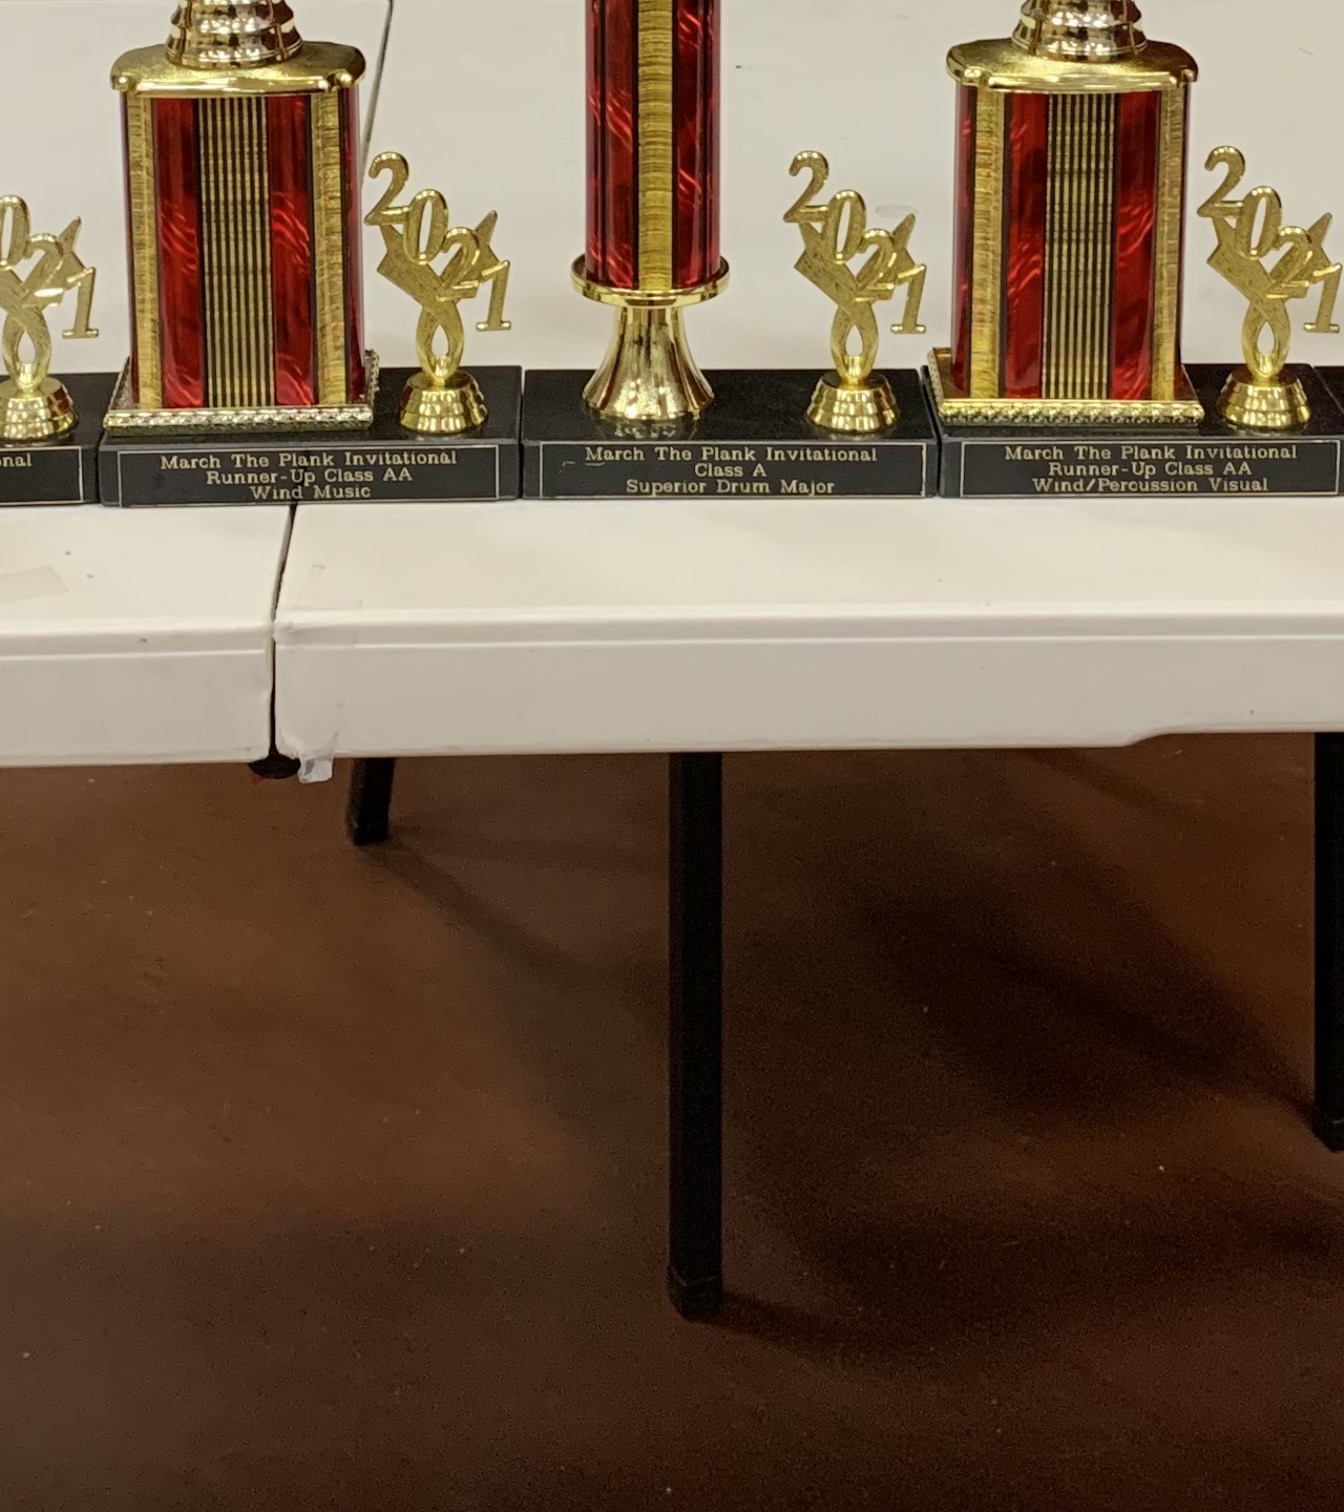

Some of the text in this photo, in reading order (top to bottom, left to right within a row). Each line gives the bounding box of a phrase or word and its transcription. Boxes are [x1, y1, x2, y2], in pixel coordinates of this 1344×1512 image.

[364, 151, 511, 331] 2021
[783, 150, 927, 333] 2021
[1196, 145, 1341, 332] 2021
[161, 451, 457, 469] March The Plank Invitational
[585, 448, 877, 461] March The Plank Invitational
[1005, 445, 1297, 460] March The Plank Invitational
[206, 468, 412, 485] Runner-Up Class AA
[694, 464, 767, 477] Class A
[1049, 462, 1252, 478] Runner-Up Class AA
[250, 485, 371, 499] Wind Music
[626, 480, 834, 497] Superior Drum Major
[1033, 478, 1268, 492] Wind/Percussion Visual
